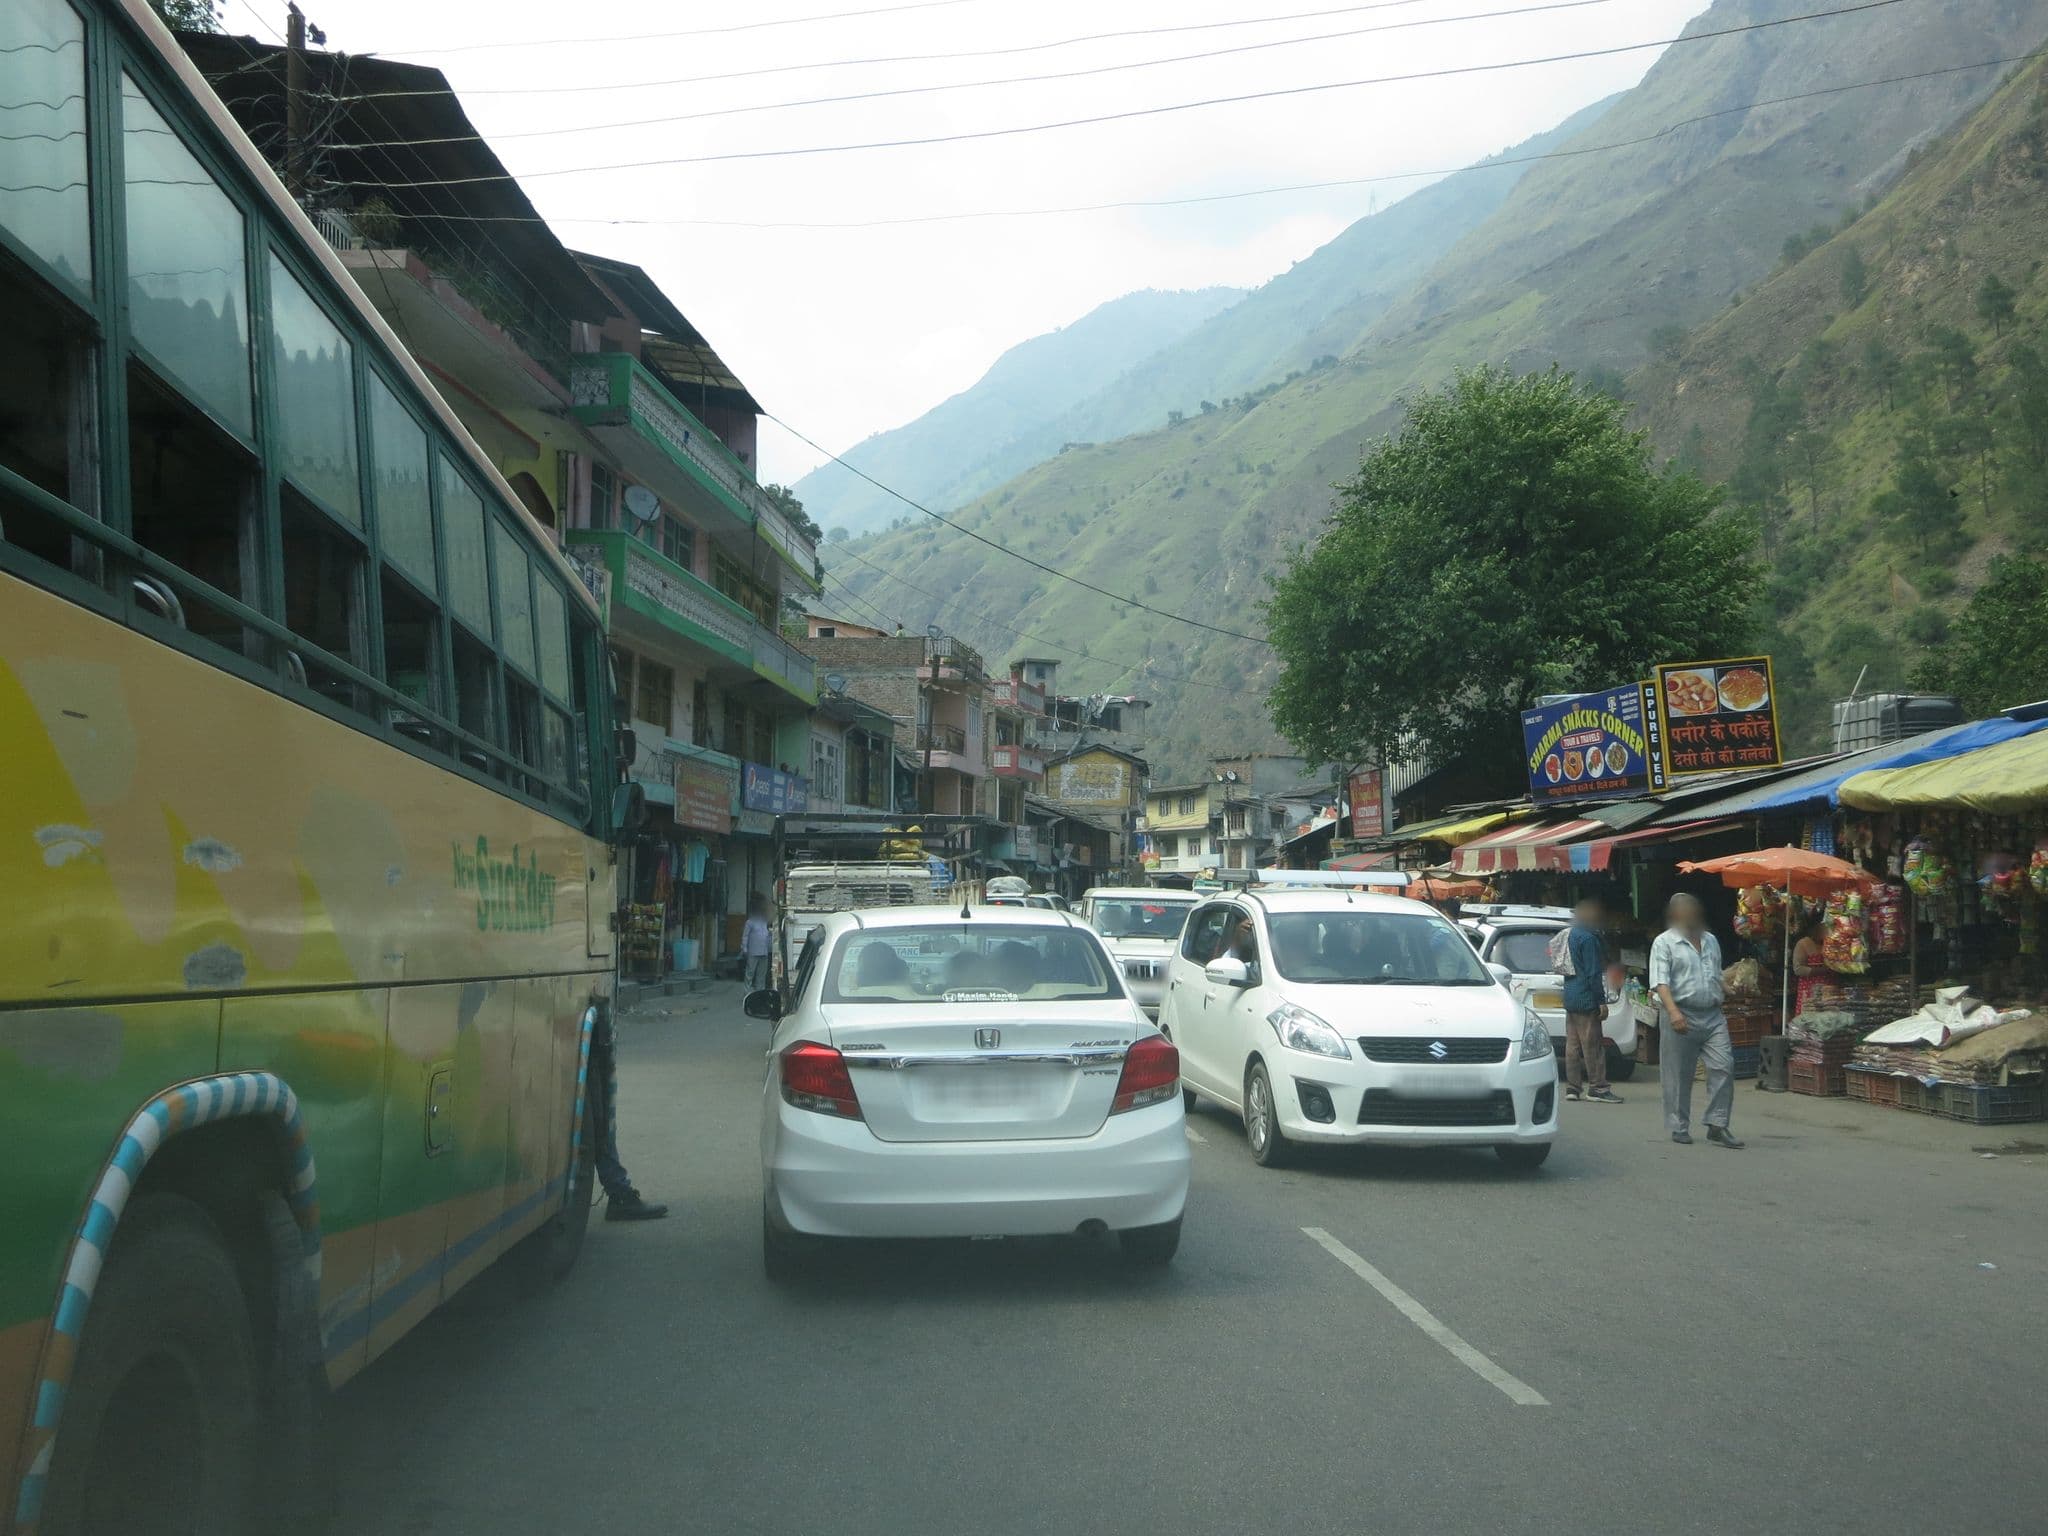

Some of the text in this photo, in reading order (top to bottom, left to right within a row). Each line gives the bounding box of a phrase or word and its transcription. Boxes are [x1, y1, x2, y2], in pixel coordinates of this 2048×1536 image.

[1530, 709, 1644, 774] SHARMA SNACKS CORNER
[1580, 732, 1600, 743] TRAVELS
[1647, 699, 1663, 785] PURE VEG
[1671, 714, 1771, 744] पनीर के पकौड़े
[1673, 743, 1773, 767] देसी घी की जलेबी
[452, 839, 475, 889] New
[840, 1043, 887, 1051] HONDA
